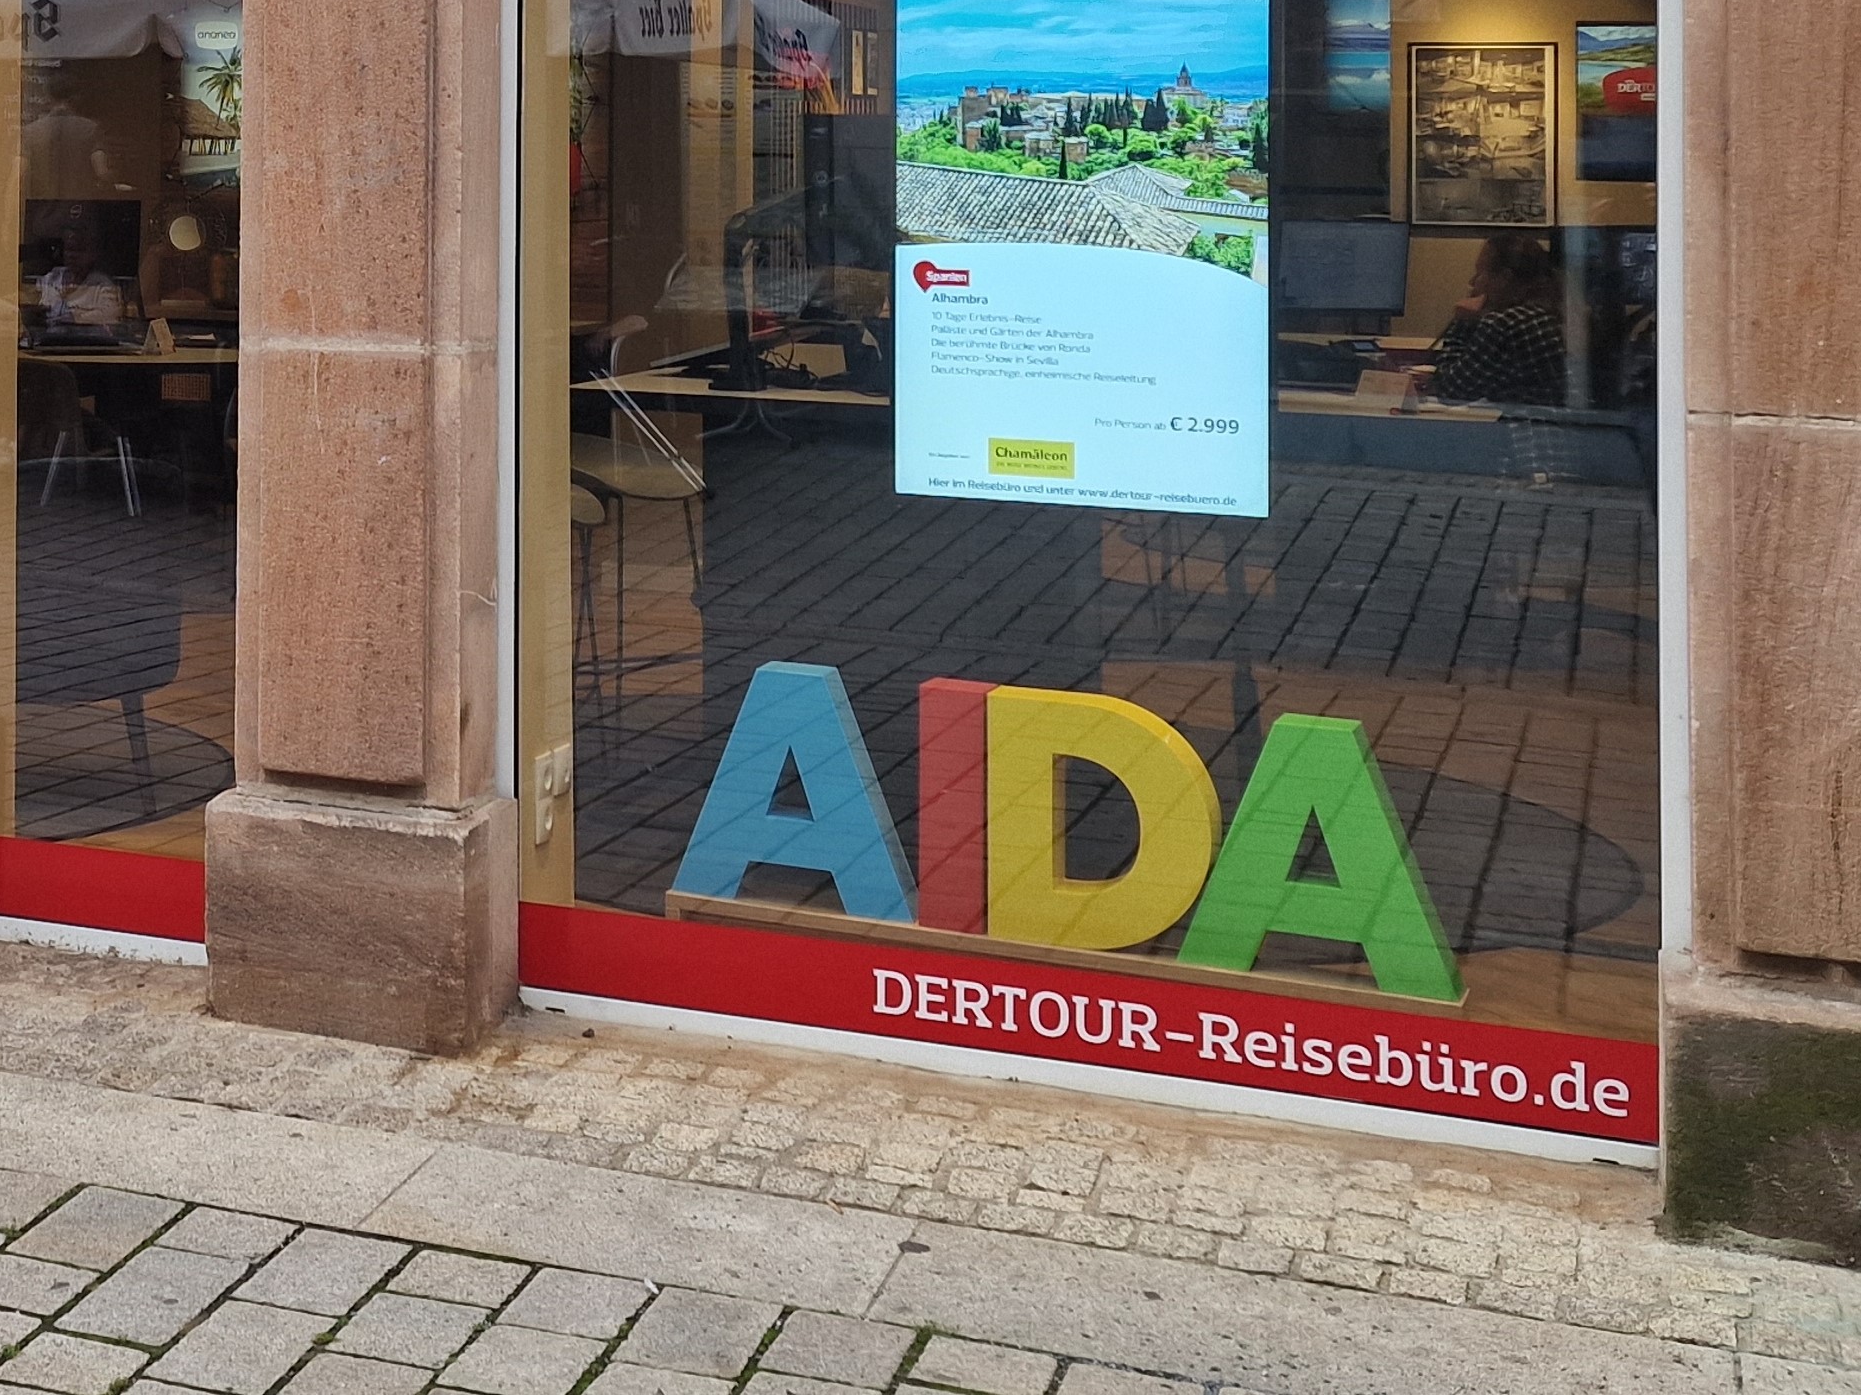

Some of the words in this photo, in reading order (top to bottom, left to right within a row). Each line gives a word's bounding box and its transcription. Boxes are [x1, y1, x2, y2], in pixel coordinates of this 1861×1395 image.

[931, 293, 989, 305] Alhambra
[1114, 418, 1151, 430] Person
[1187, 417, 1240, 435] 2.999
[994, 445, 1069, 462] Chamäleon
[928, 477, 950, 489] Hier
[670, 661, 1468, 1002] AIDA
[871, 967, 1630, 1119] DERTOUR-Reisebüro.de
